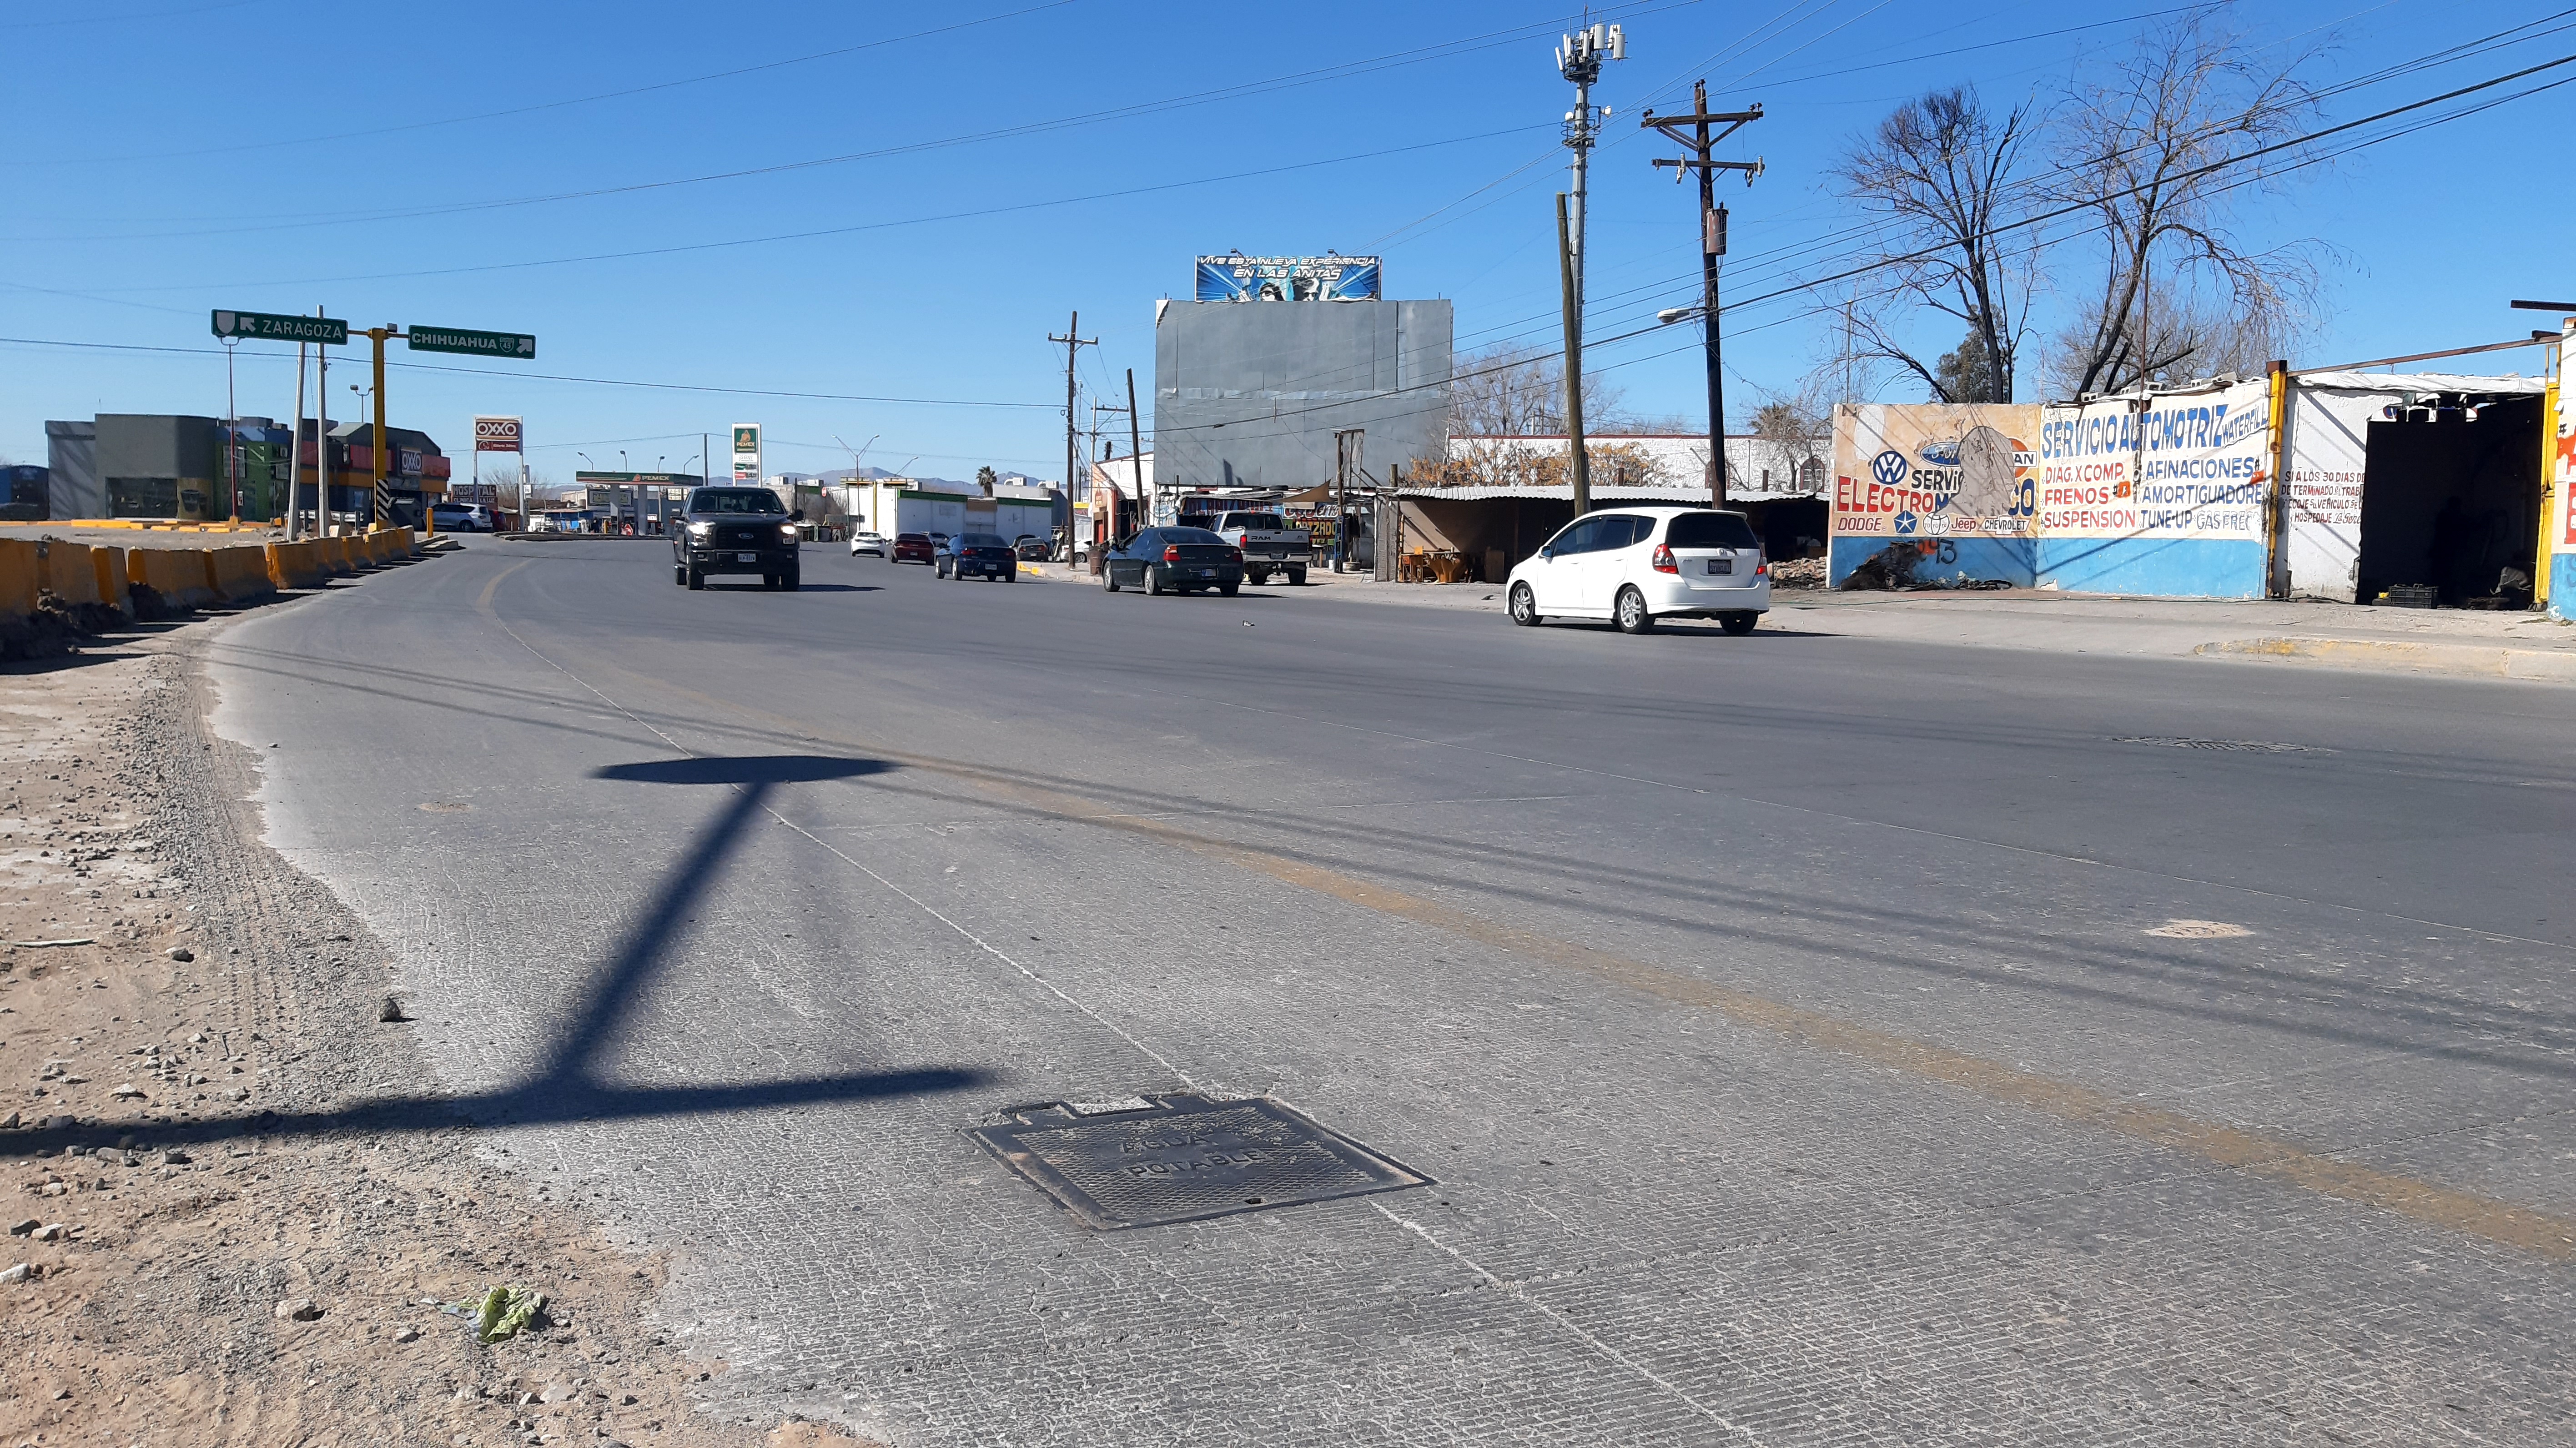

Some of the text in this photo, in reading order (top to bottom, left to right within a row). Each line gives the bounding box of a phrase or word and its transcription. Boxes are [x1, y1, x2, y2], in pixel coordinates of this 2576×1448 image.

[1200, 256, 1375, 267] VIVE ESTA NUEVA EXPERIENCIA
[1233, 269, 1342, 280] EN LAS ANITAS
[262, 320, 342, 338] ZARAGOZA
[412, 332, 497, 349] CHIHUAHUA
[477, 422, 517, 436] OXXO
[2042, 414, 2118, 459] SERVICIO
[2119, 404, 2229, 452] AUTOMOTRIZ
[402, 452, 422, 470] OXXO
[2146, 456, 2255, 480] AFINACIONES
[2084, 462, 2125, 483] COMP.
[2285, 471, 2294, 482] SI
[2295, 471, 2301, 482] A
[2303, 471, 2320, 483] LOS
[2322, 472, 2334, 483] 30
[2335, 472, 2355, 483] DIAS
[453, 485, 495, 496] HOSPTAL
[2044, 486, 2109, 506] FRENOS
[2317, 498, 2349, 509] VEHICULO
[1837, 518, 1882, 531] DODGE
[1951, 517, 1977, 532] Jeep
[1984, 520, 2026, 531] CHEVROLET
[2044, 509, 2136, 528] SUSPENSION
[2197, 510, 2221, 530] GAS
[2294, 512, 2332, 523] HOSPEDAJE
[1124, 1150, 1267, 1178] POTABLE
